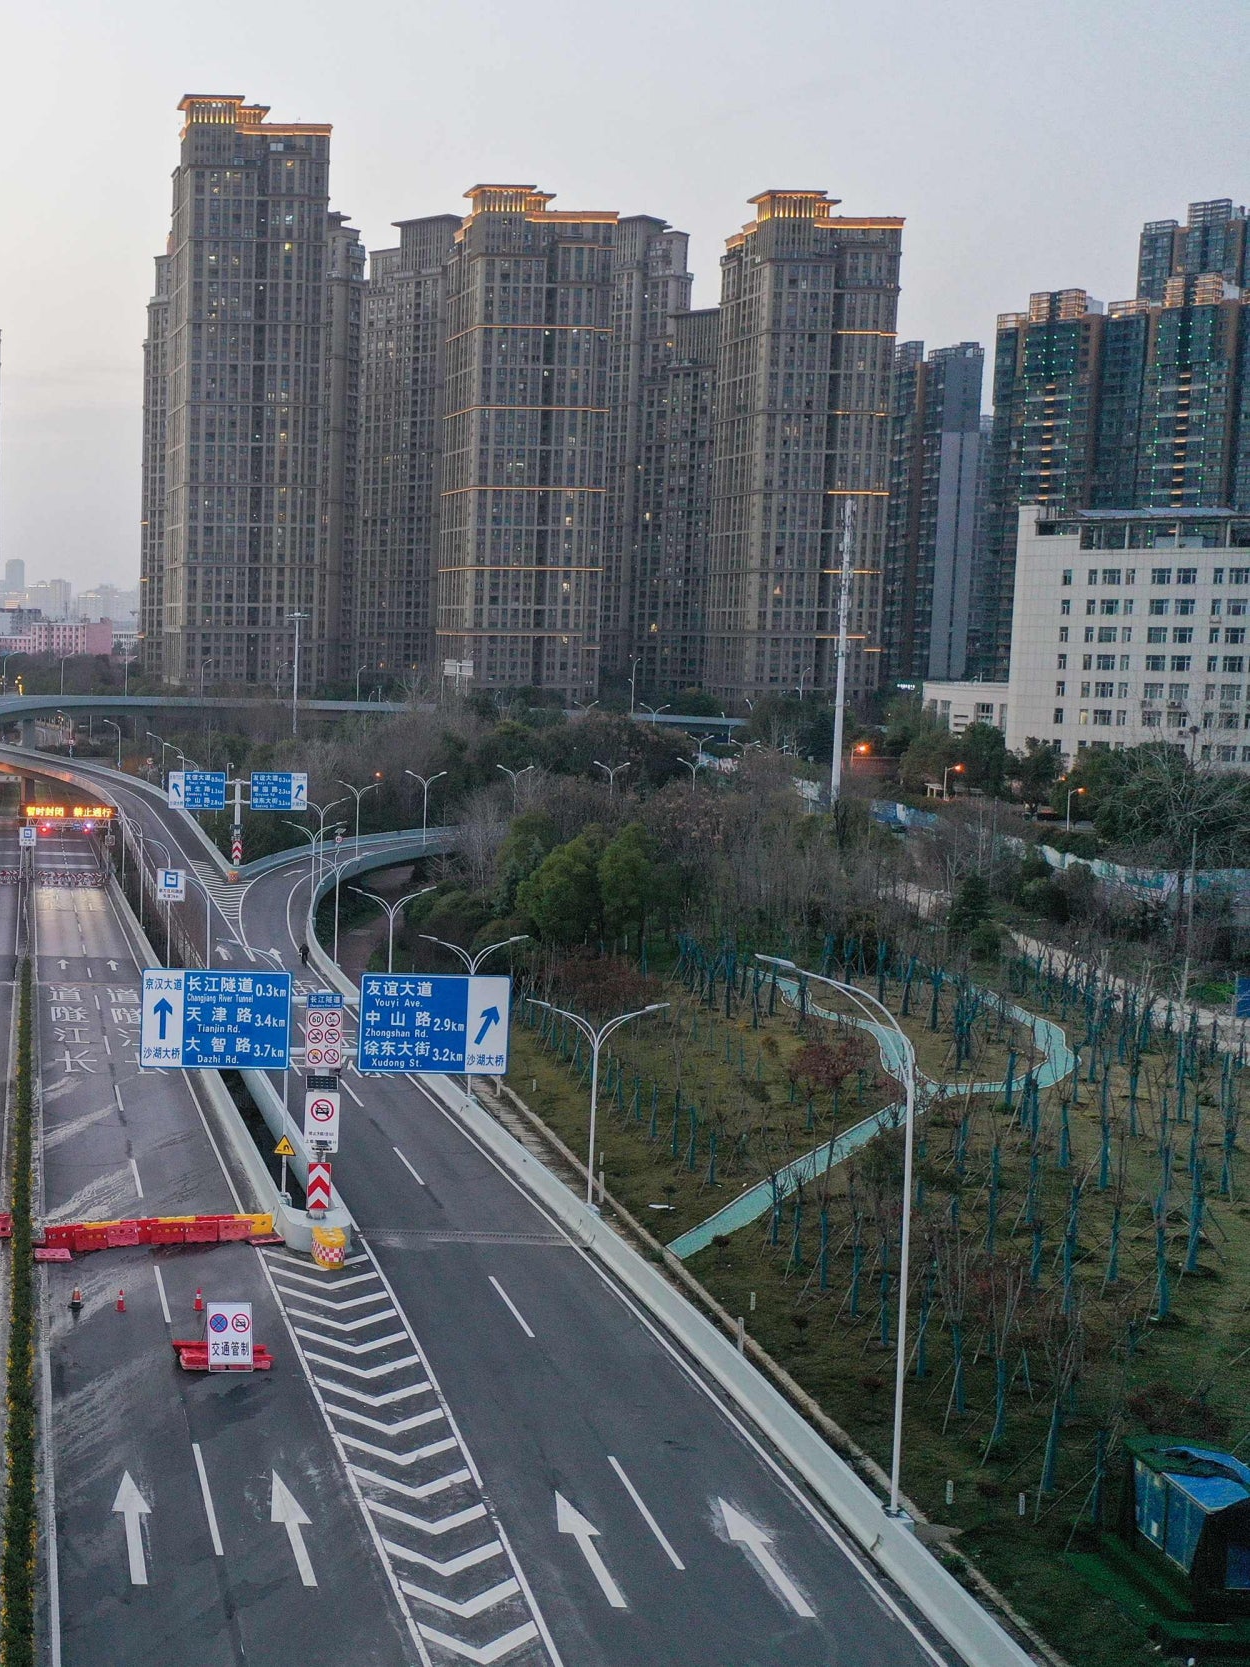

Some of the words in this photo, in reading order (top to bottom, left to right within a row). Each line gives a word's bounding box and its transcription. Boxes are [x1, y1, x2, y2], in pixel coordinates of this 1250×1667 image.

[26, 806, 64, 817] 暂时封闭
[73, 807, 113, 817] 禁止通行
[145, 978, 182, 990] 京汉大道
[187, 976, 253, 993] 长江隧道
[255, 984, 287, 997] 0.3km
[366, 980, 433, 997] 友谊大道
[187, 993, 216, 1004] Changjiang
[218, 994, 233, 1003] River
[235, 994, 254, 1003] Tunnel
[310, 995, 341, 1004] 长江隧道
[375, 998, 399, 1008] Youyi
[404, 998, 423, 1008] Ave.
[186, 1006, 252, 1023] 天津路
[254, 1014, 286, 1027] 3.4km
[365, 1010, 431, 1027] 中山路
[197, 1024, 225, 1034] Tianjin
[227, 1024, 241, 1033] Rd.
[433, 1018, 465, 1032] 2.9km
[365, 1028, 410, 1039] Zhongshan
[414, 1029, 429, 1038] Rd.
[185, 1036, 252, 1053] 大智路
[253, 1044, 285, 1058] 3.7km
[364, 1040, 431, 1057] 徐东大街
[143, 1047, 181, 1060] 沙湖大桥
[197, 1054, 221, 1064] Dazhi
[225, 1055, 239, 1064] Rd.
[432, 1048, 463, 1062] 3.2km
[371, 1058, 405, 1068] Xudong
[409, 1058, 422, 1068] St.
[466, 1054, 504, 1067] 沙湖大桥
[211, 1341, 250, 1356] 交通管制
